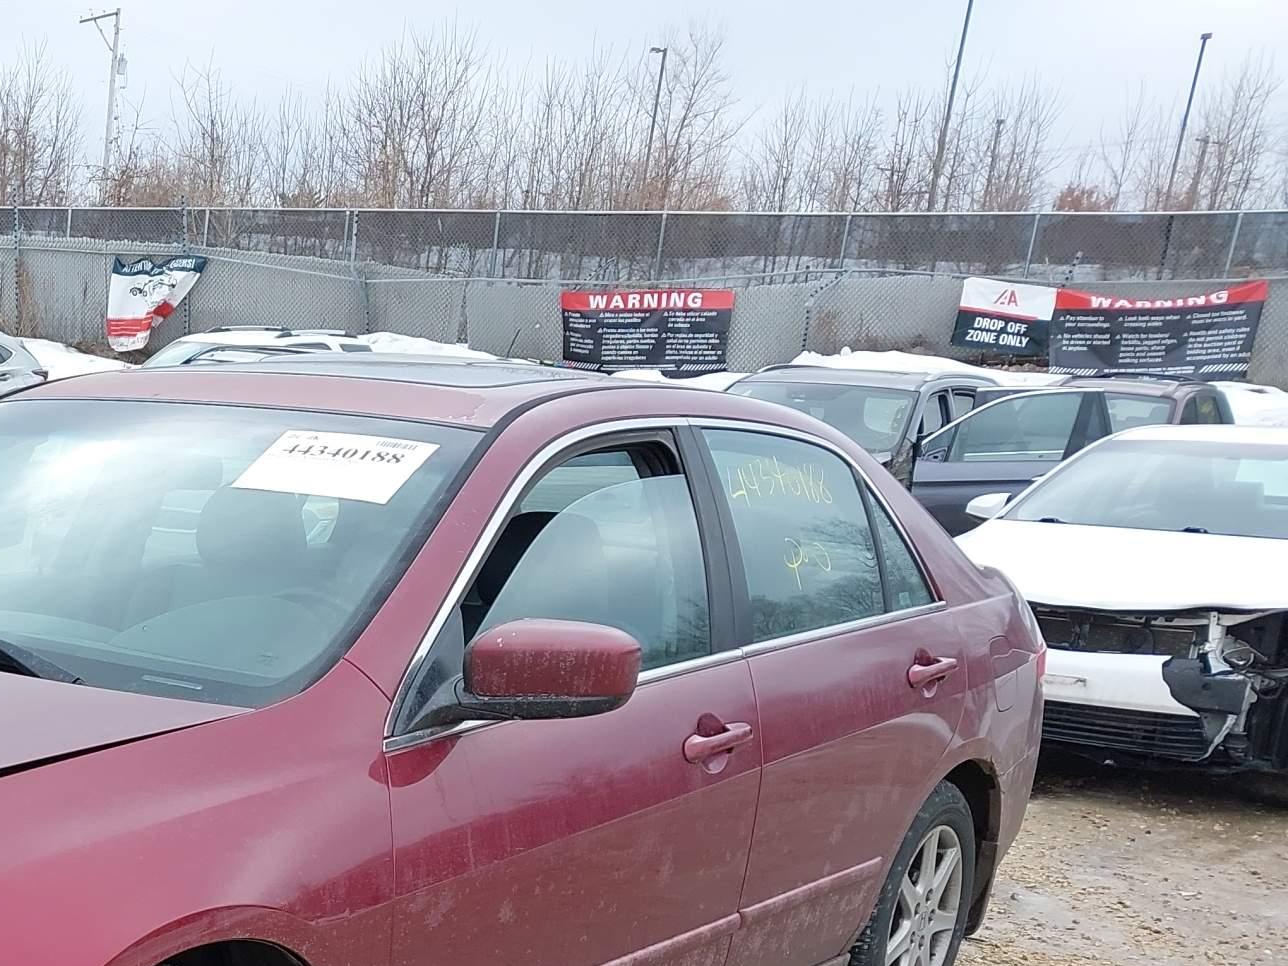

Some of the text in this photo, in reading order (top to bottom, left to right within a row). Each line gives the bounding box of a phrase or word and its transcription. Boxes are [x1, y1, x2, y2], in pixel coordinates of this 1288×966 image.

[589, 292, 704, 309] WARNING
[974, 317, 1028, 334] DROP OFF
[965, 330, 1030, 348] ZONE ONLY
[282, 443, 405, 465] 44340188
